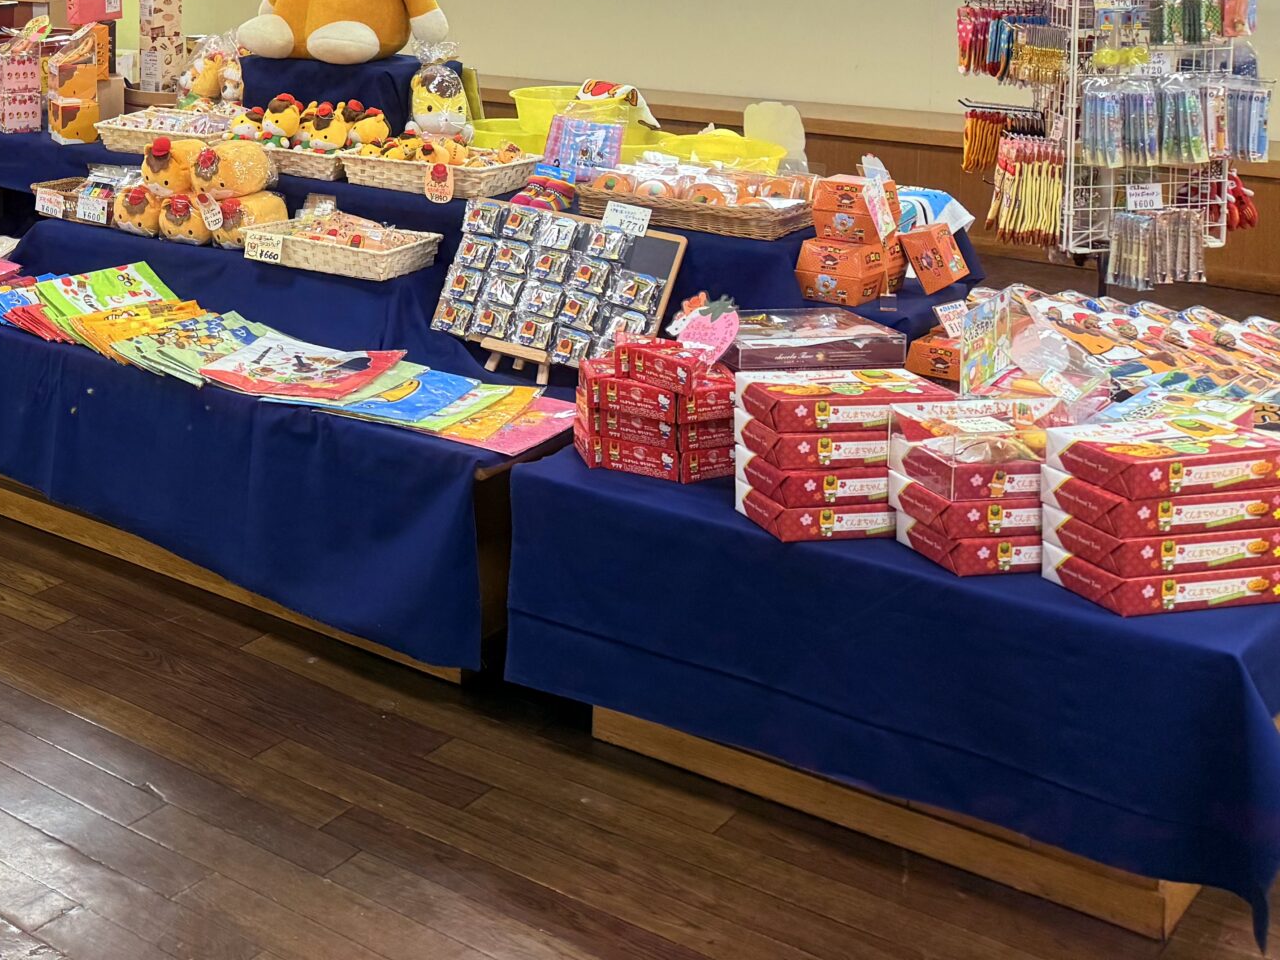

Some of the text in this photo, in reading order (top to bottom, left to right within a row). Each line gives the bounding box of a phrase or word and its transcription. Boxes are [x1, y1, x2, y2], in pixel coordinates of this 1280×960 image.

[1134, 199, 1155, 208] ¥600
[41, 204, 58, 216] ¥600
[83, 211, 101, 222] ¥600
[619, 219, 645, 233] ¥770
[259, 249, 279, 261] ¥660
